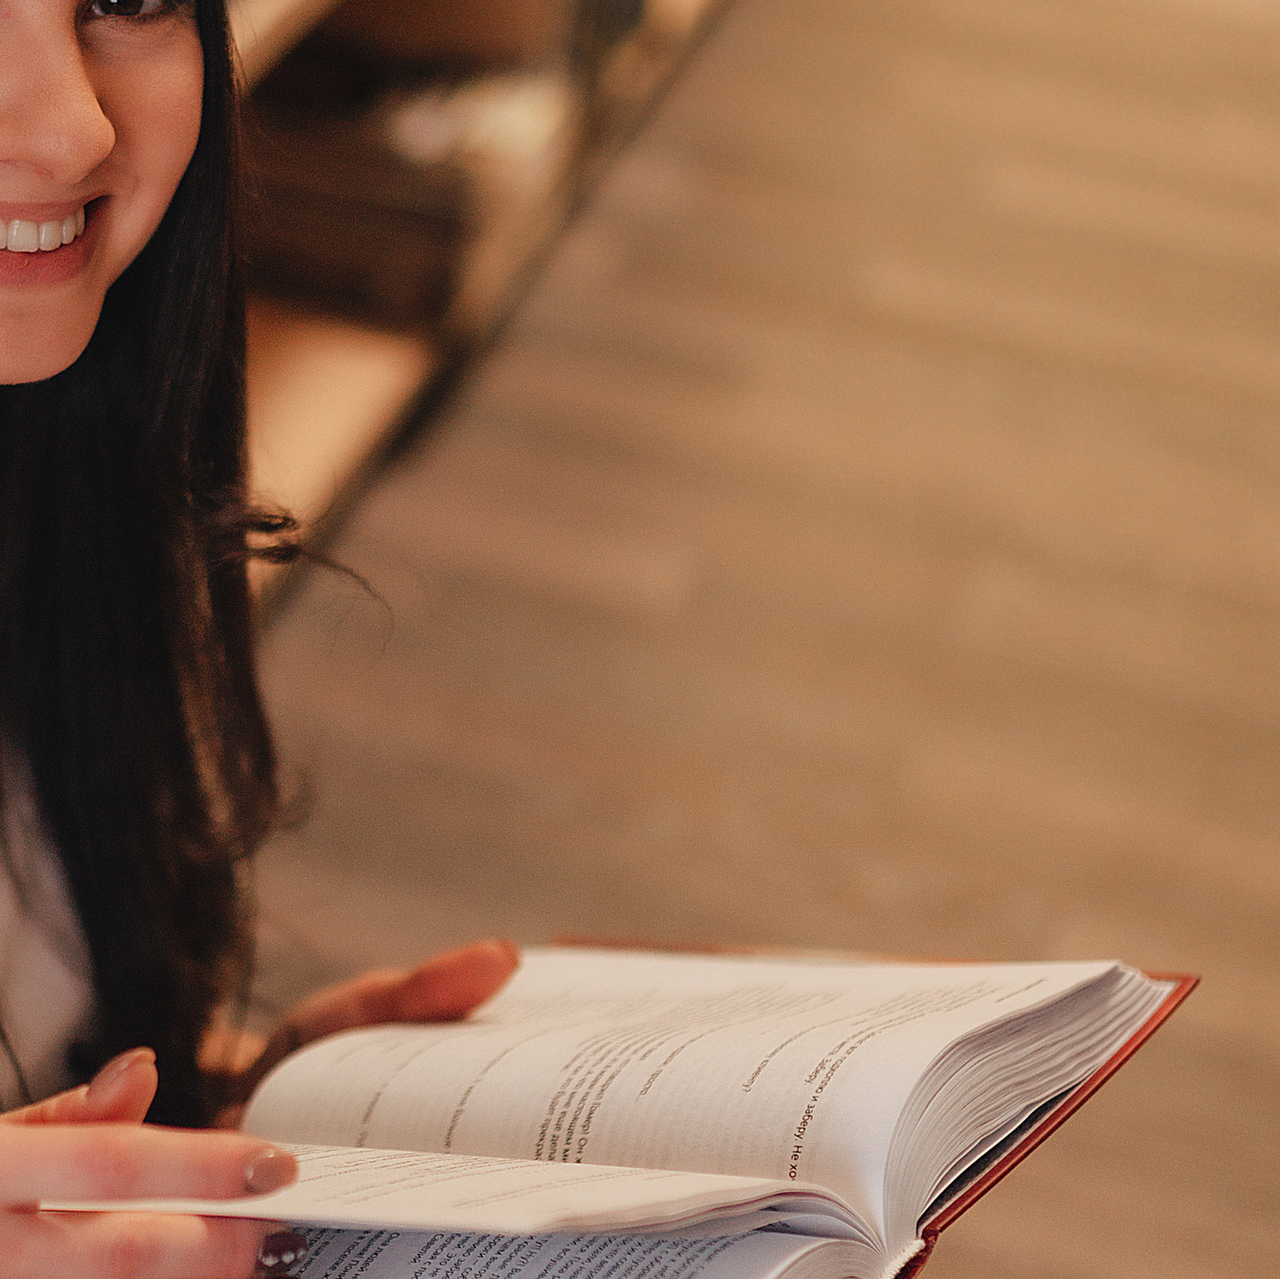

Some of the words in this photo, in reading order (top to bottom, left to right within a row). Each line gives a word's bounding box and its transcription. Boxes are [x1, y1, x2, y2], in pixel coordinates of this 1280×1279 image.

[794, 1104, 815, 1141] заберу.
[577, 1139, 588, 1154] Он
[792, 1146, 803, 1161] Не
[383, 1232, 397, 1246] Она
[329, 1241, 357, 1271] поселке
[359, 1247, 383, 1272] людей
